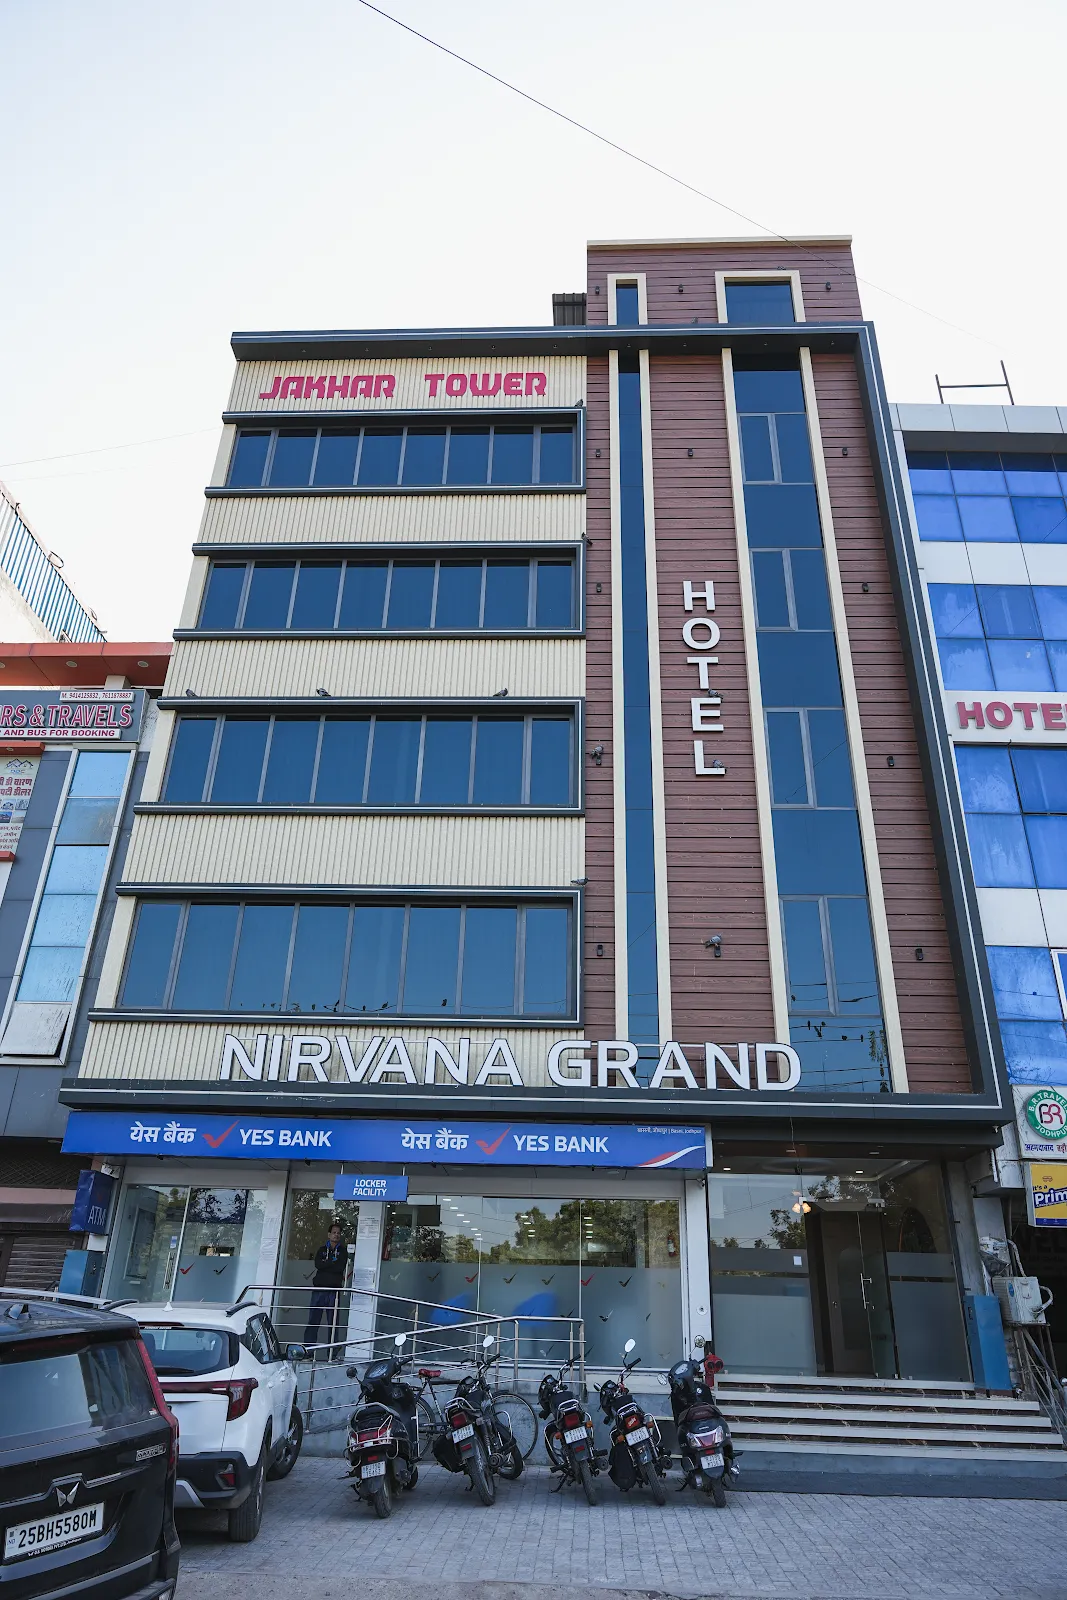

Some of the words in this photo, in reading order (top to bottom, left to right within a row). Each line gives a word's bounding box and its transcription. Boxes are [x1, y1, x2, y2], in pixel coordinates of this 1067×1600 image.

[259, 374, 396, 400] JAKHAR
[424, 372, 547, 397] TOWER
[682, 580, 727, 776] HOTEL
[0, 704, 27, 728] RS
[28, 704, 45, 727] &
[47, 704, 134, 728] TRAVELS
[956, 701, 1067, 730] HOTE
[219, 1033, 524, 1086] NIRVANA
[547, 1039, 801, 1091] GRAND
[130, 1121, 160, 1143] येस
[163, 1121, 197, 1144] बैंक
[239, 1129, 274, 1146] YES
[278, 1130, 333, 1147] BANK
[401, 1128, 432, 1150] येस
[435, 1128, 469, 1151] बैंक
[513, 1135, 549, 1152] YES
[554, 1136, 609, 1153] BANK
[352, 1187, 387, 1197] FACILITY
[354, 1179, 387, 1188] LOCKER
[88, 1206, 107, 1226] ATM
